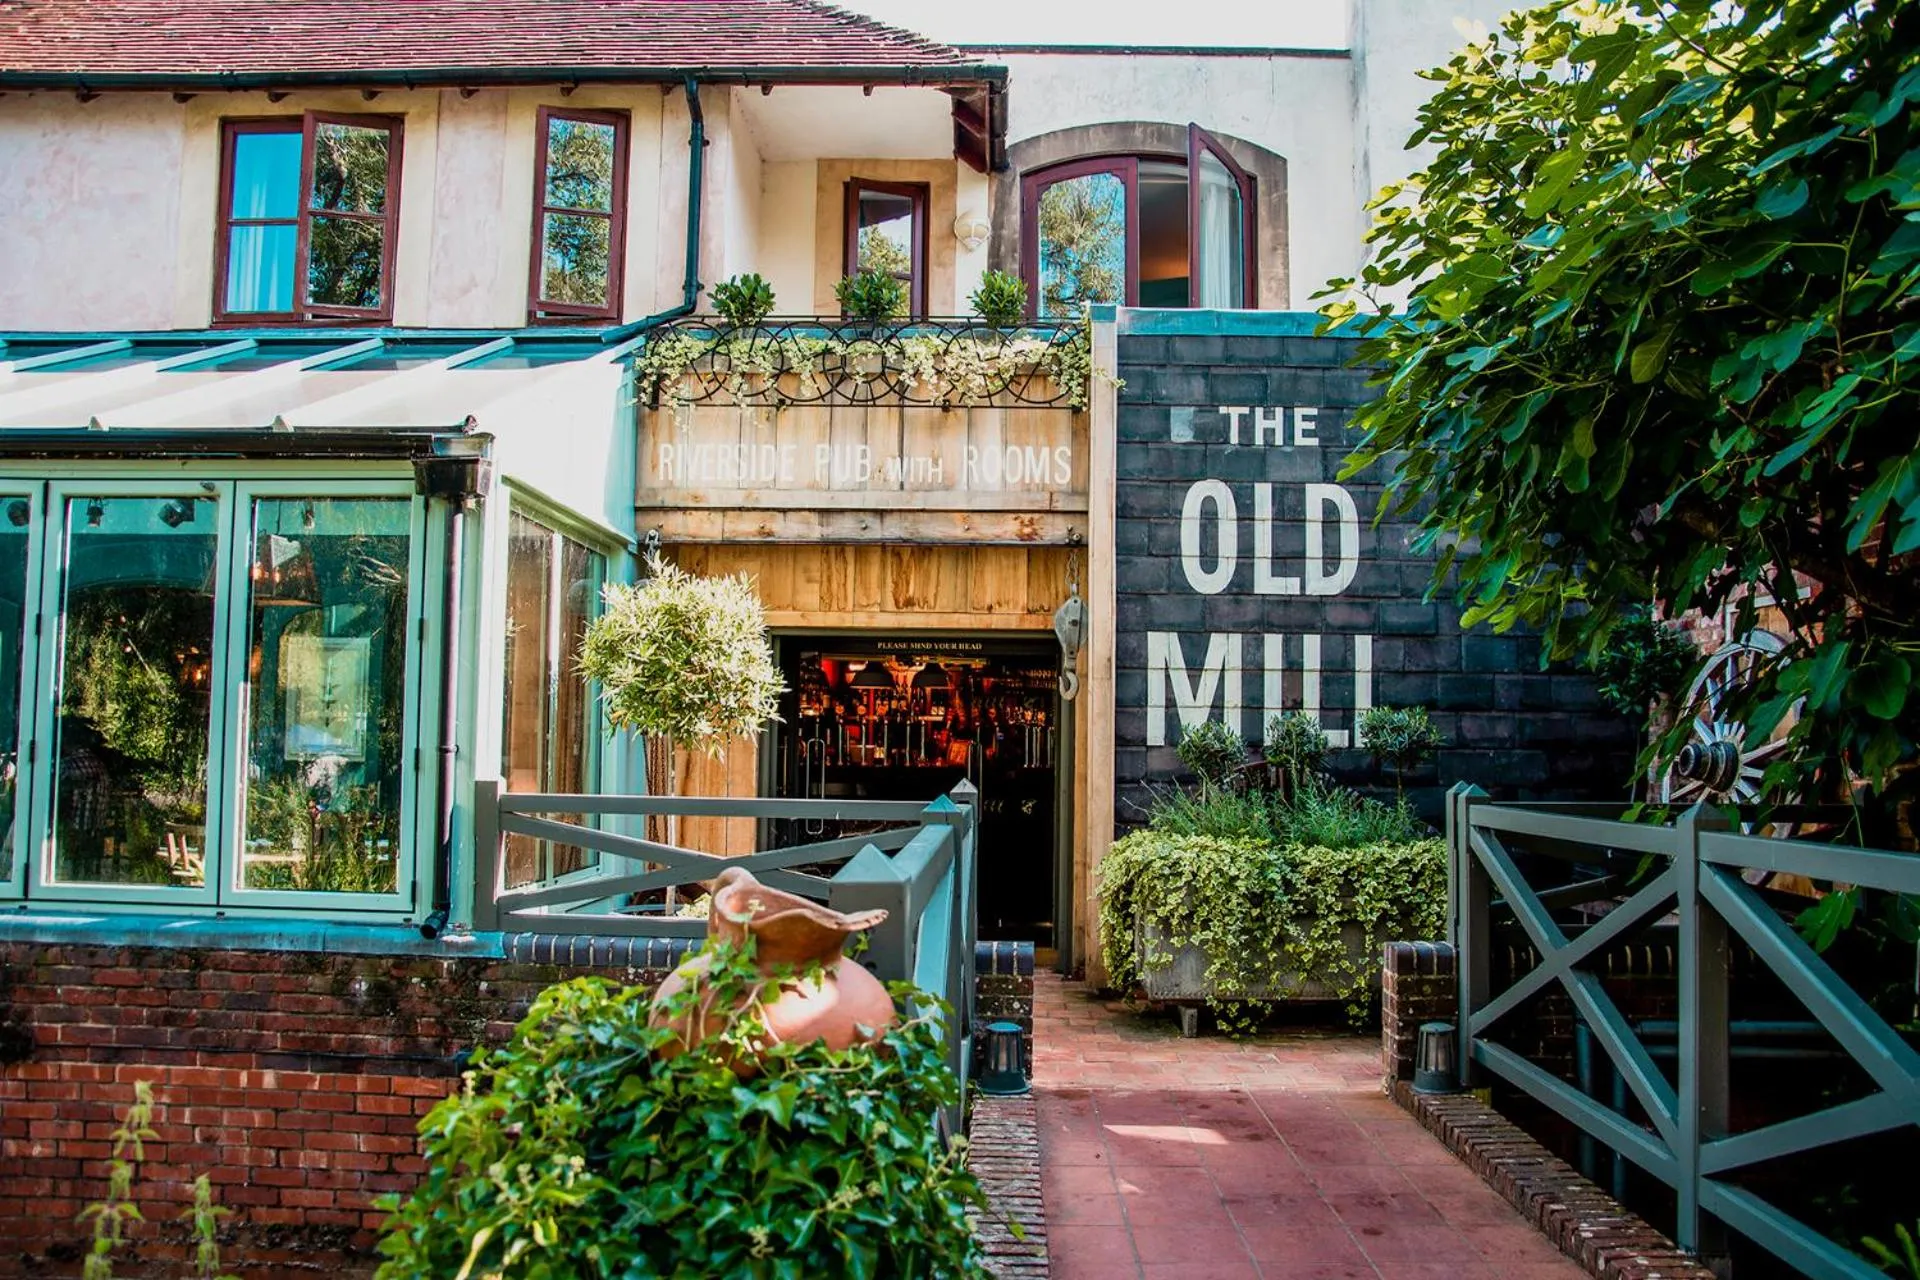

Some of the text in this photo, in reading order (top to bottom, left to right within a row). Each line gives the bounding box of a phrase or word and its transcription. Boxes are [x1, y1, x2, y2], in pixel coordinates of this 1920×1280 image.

[1219, 406, 1319, 446] THE
[658, 443, 1072, 485] RIVERSIDE PUB WITH ROOMS
[1180, 479, 1360, 596] OLD
[877, 642, 983, 651] PLEASE MIND YOUR HEAD
